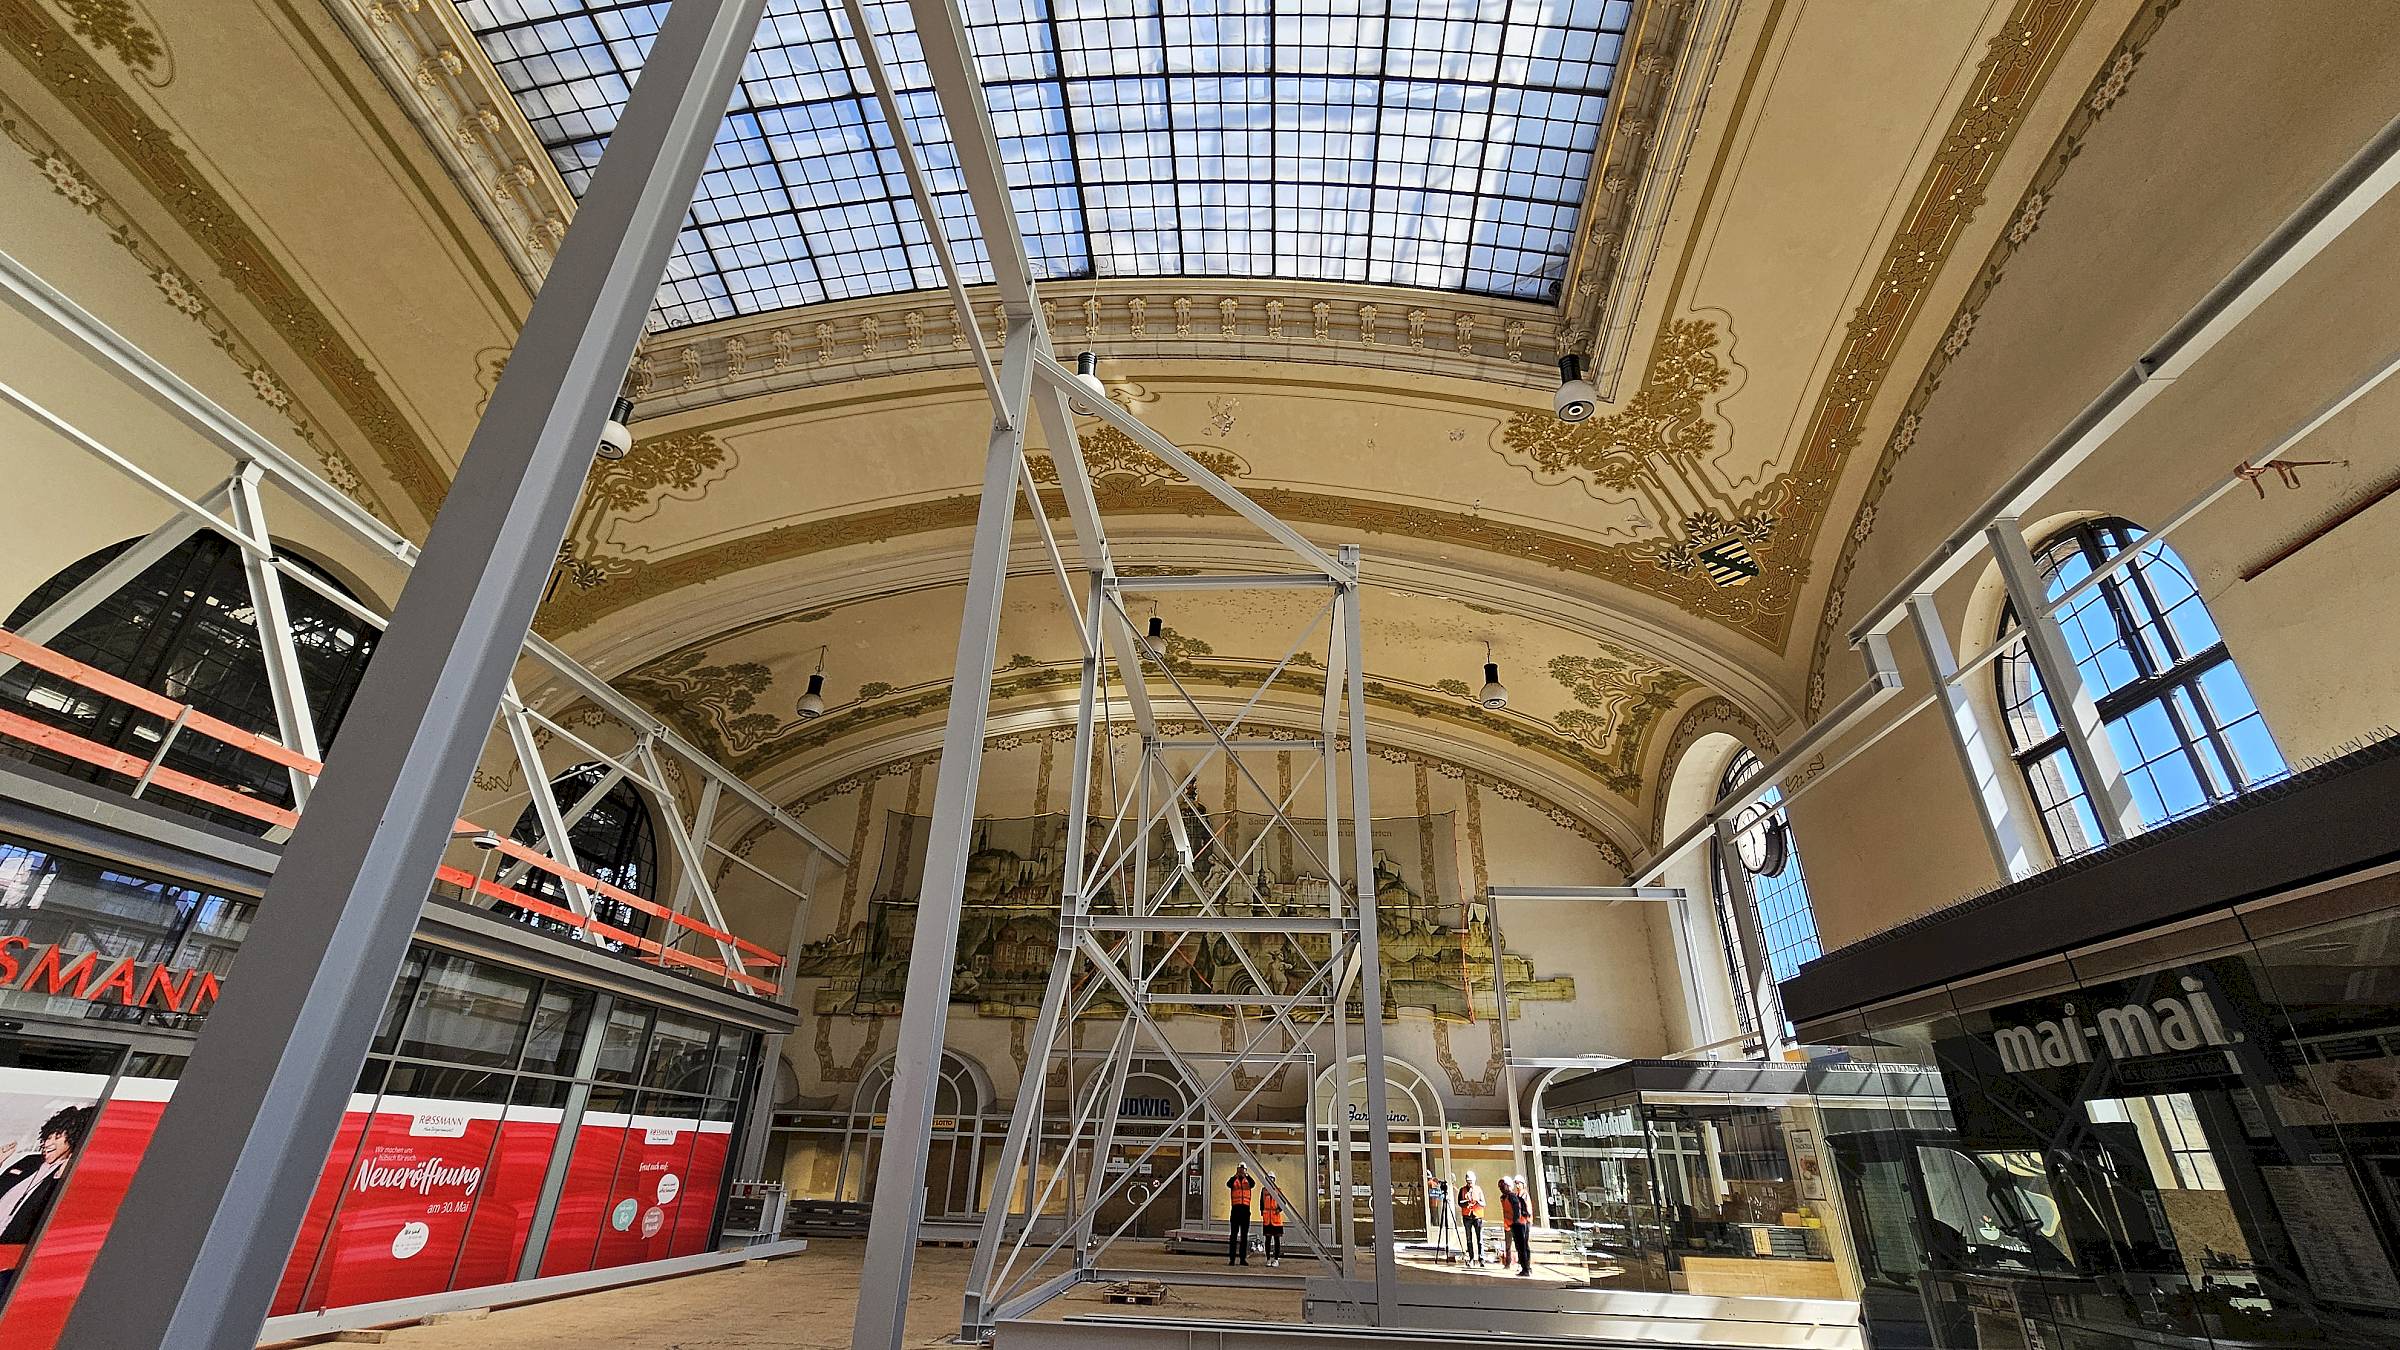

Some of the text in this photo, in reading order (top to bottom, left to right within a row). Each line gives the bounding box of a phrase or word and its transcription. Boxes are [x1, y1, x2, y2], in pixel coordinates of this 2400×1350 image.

[1120, 1097, 1174, 1117] UDWIG.
[353, 1157, 481, 1196] Neueröffnung
[427, 1200, 471, 1214] am 30. Mai
